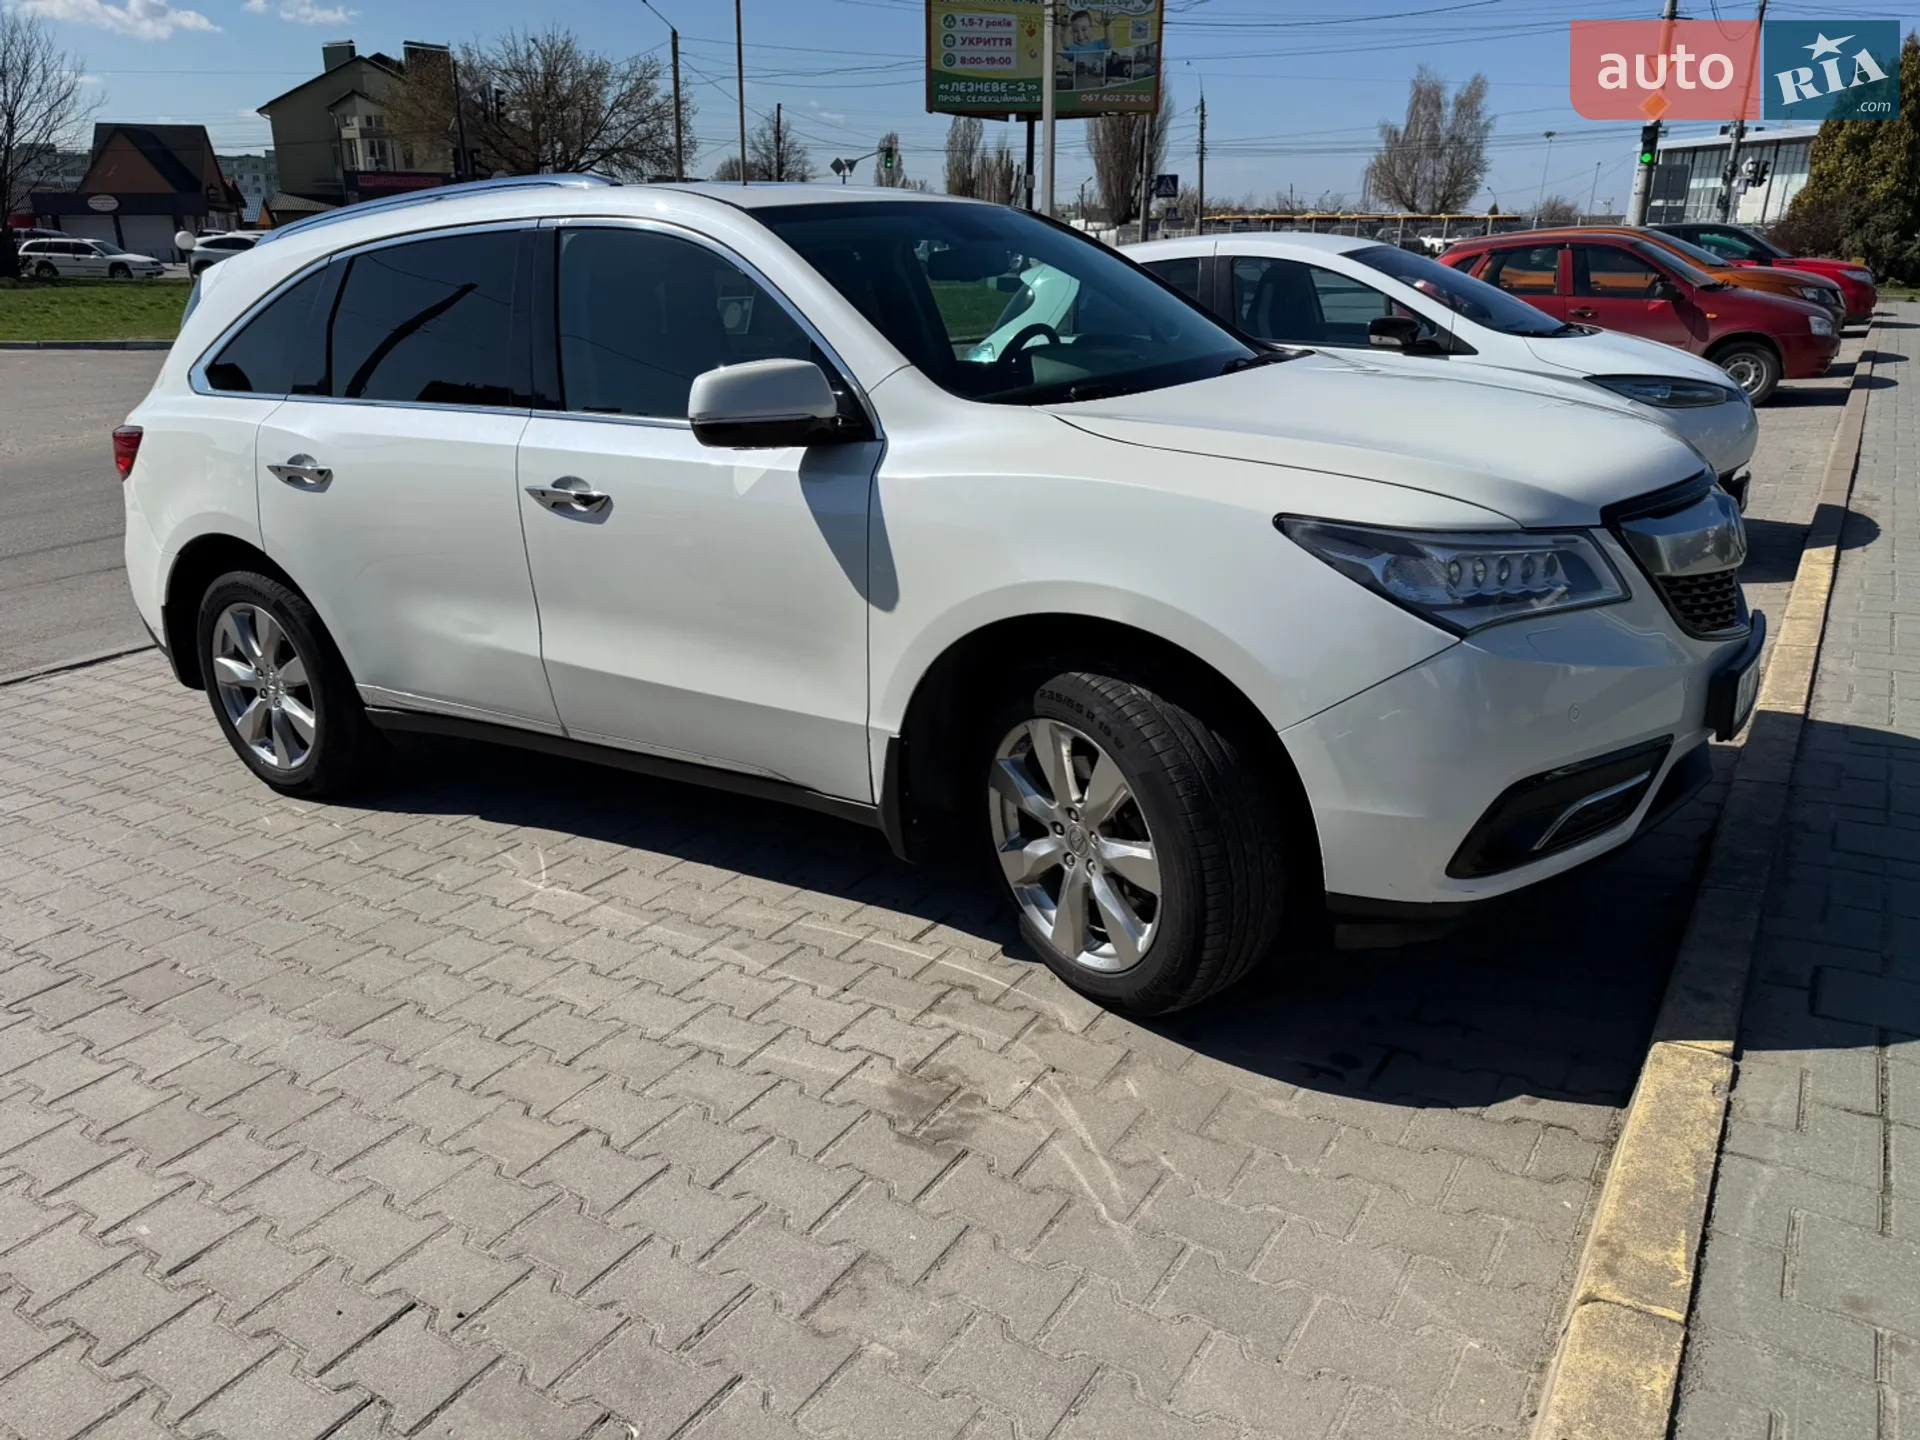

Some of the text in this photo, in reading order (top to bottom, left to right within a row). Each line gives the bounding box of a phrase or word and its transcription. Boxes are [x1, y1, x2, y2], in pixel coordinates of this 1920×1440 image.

[960, 17, 1012, 28] 1,5-7 років
[960, 36, 1012, 47] УКРИТТЯ
[960, 56, 1012, 65] 8:00-19:00
[1081, 94, 1100, 102] 067
[1102, 94, 1121, 102] 602
[1123, 94, 1136, 102] 72
[1086, 710, 1096, 723] R
